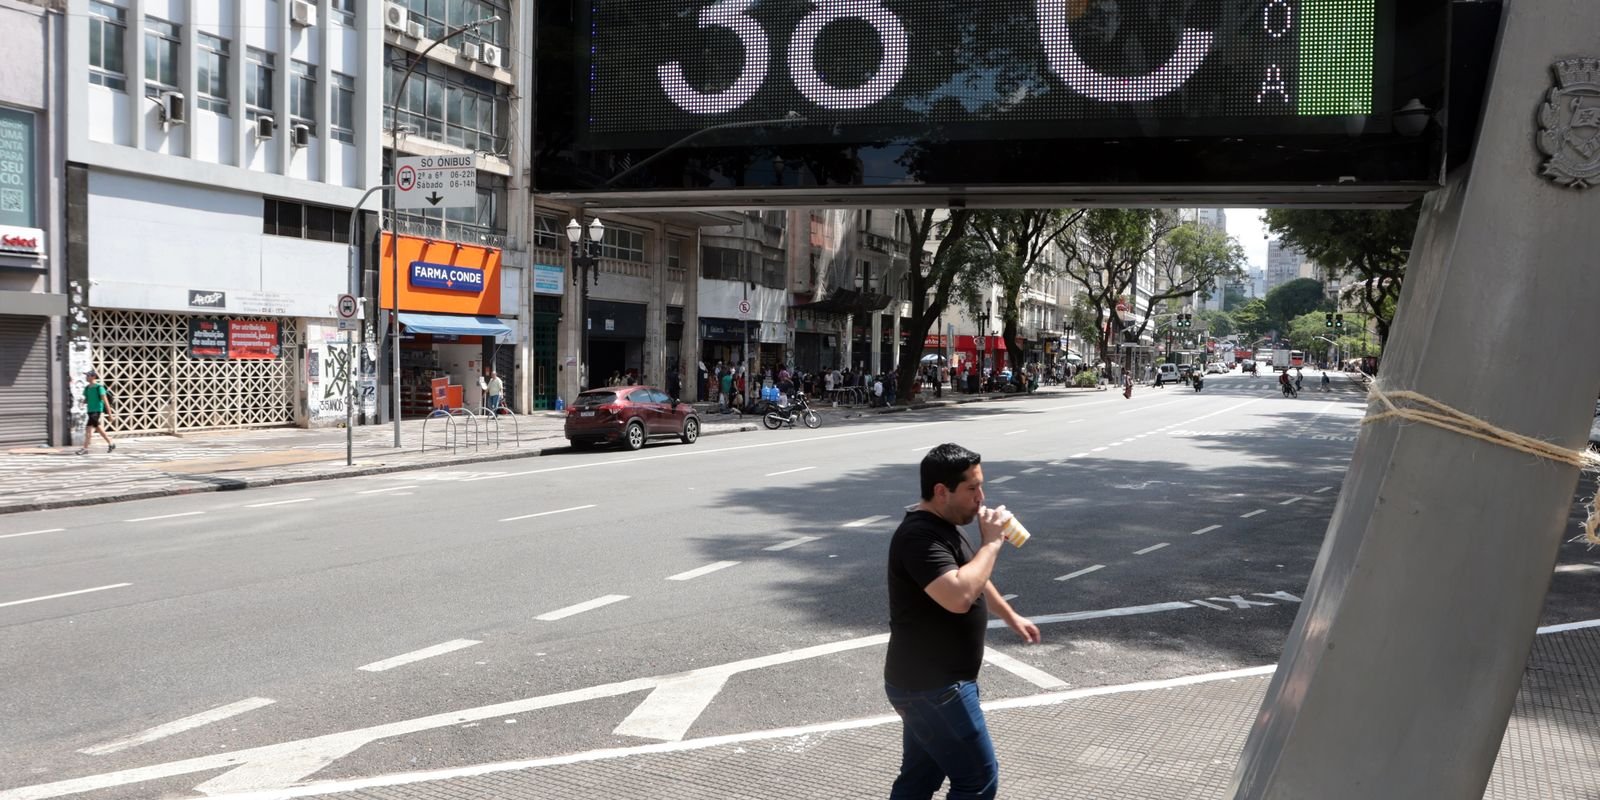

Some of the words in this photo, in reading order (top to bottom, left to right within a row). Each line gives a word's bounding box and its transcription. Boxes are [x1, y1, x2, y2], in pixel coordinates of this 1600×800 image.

[1, 160, 24, 174] SEU
[421, 156, 433, 167] SÓ
[437, 156, 471, 167] ÔNIBUS
[450, 170, 475, 178] 06-22h
[417, 181, 443, 189] Sábado
[449, 180, 475, 188] 06-14h
[2, 234, 38, 248] Select
[415, 266, 448, 280] FARMA
[450, 270, 482, 284] CONDE
